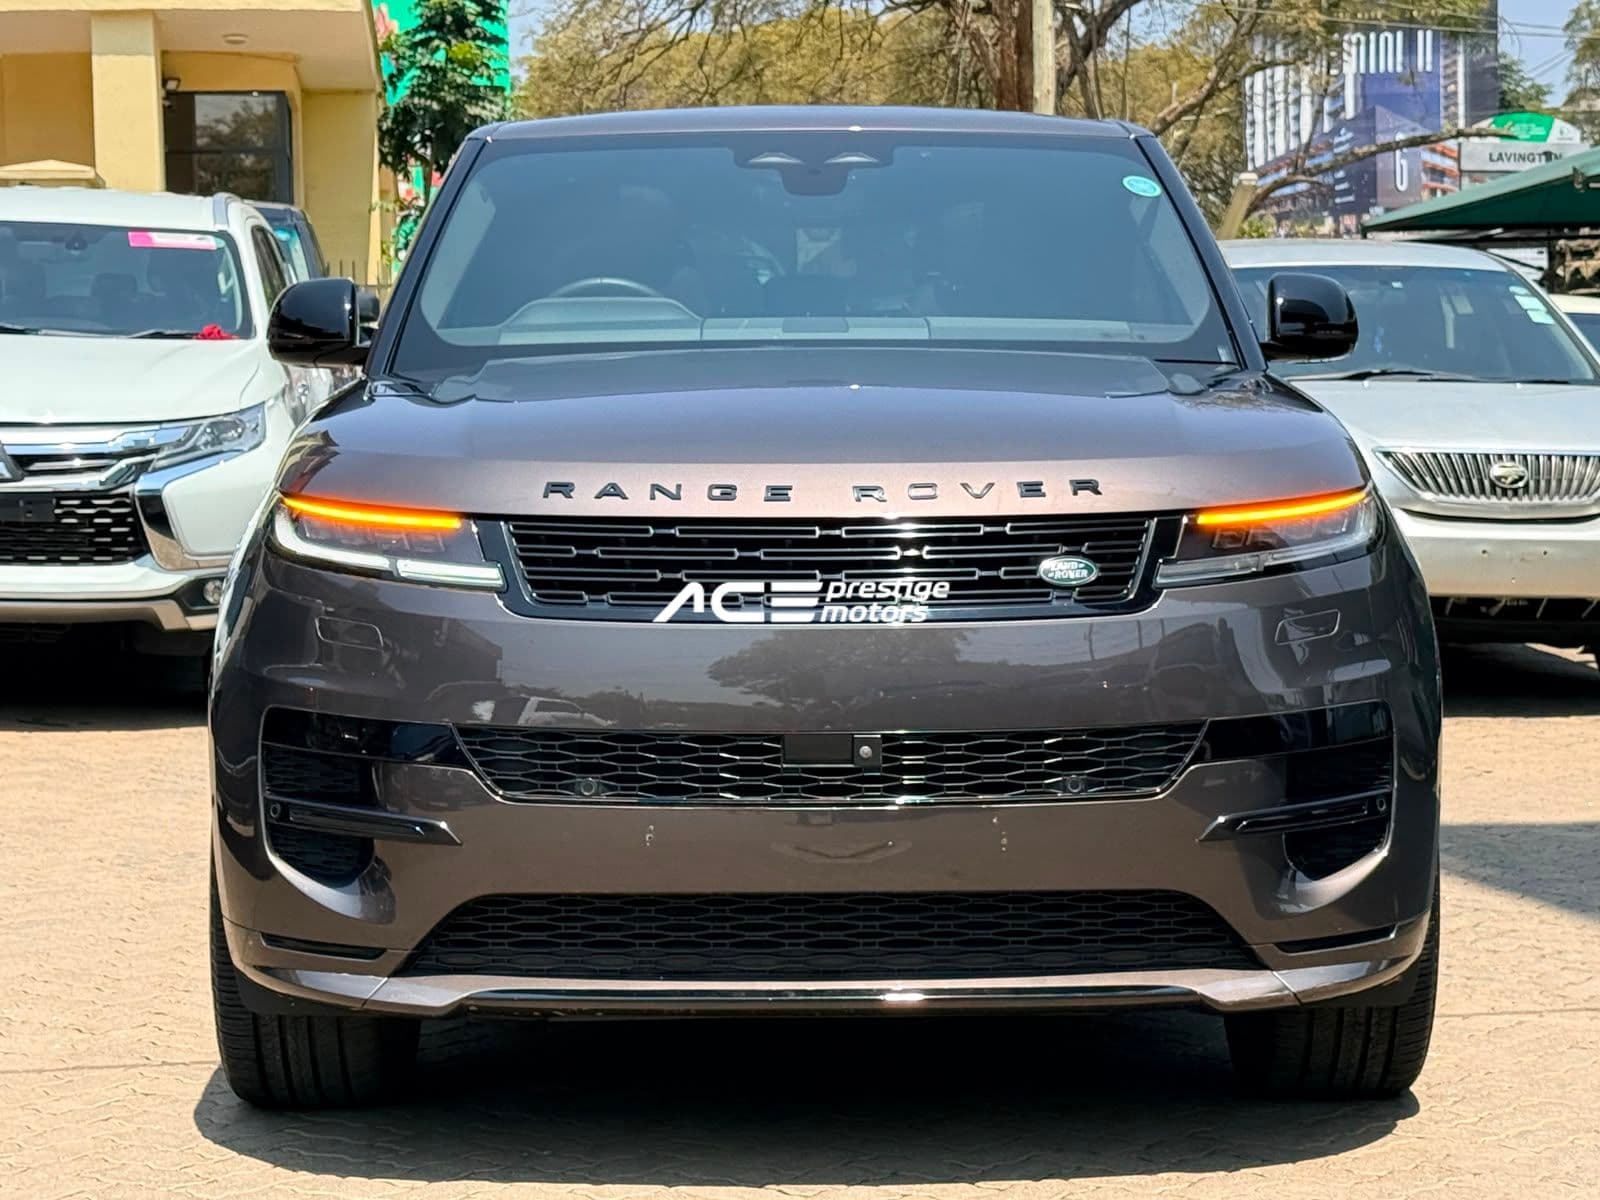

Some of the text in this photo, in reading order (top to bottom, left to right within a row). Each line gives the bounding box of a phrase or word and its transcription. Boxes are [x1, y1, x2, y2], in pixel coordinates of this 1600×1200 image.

[1489, 151, 1562, 163] LAVINGTN
[542, 479, 1103, 503] RANGE ROVER
[1050, 561, 1078, 571] LAND
[1054, 569, 1088, 579] ROVER
